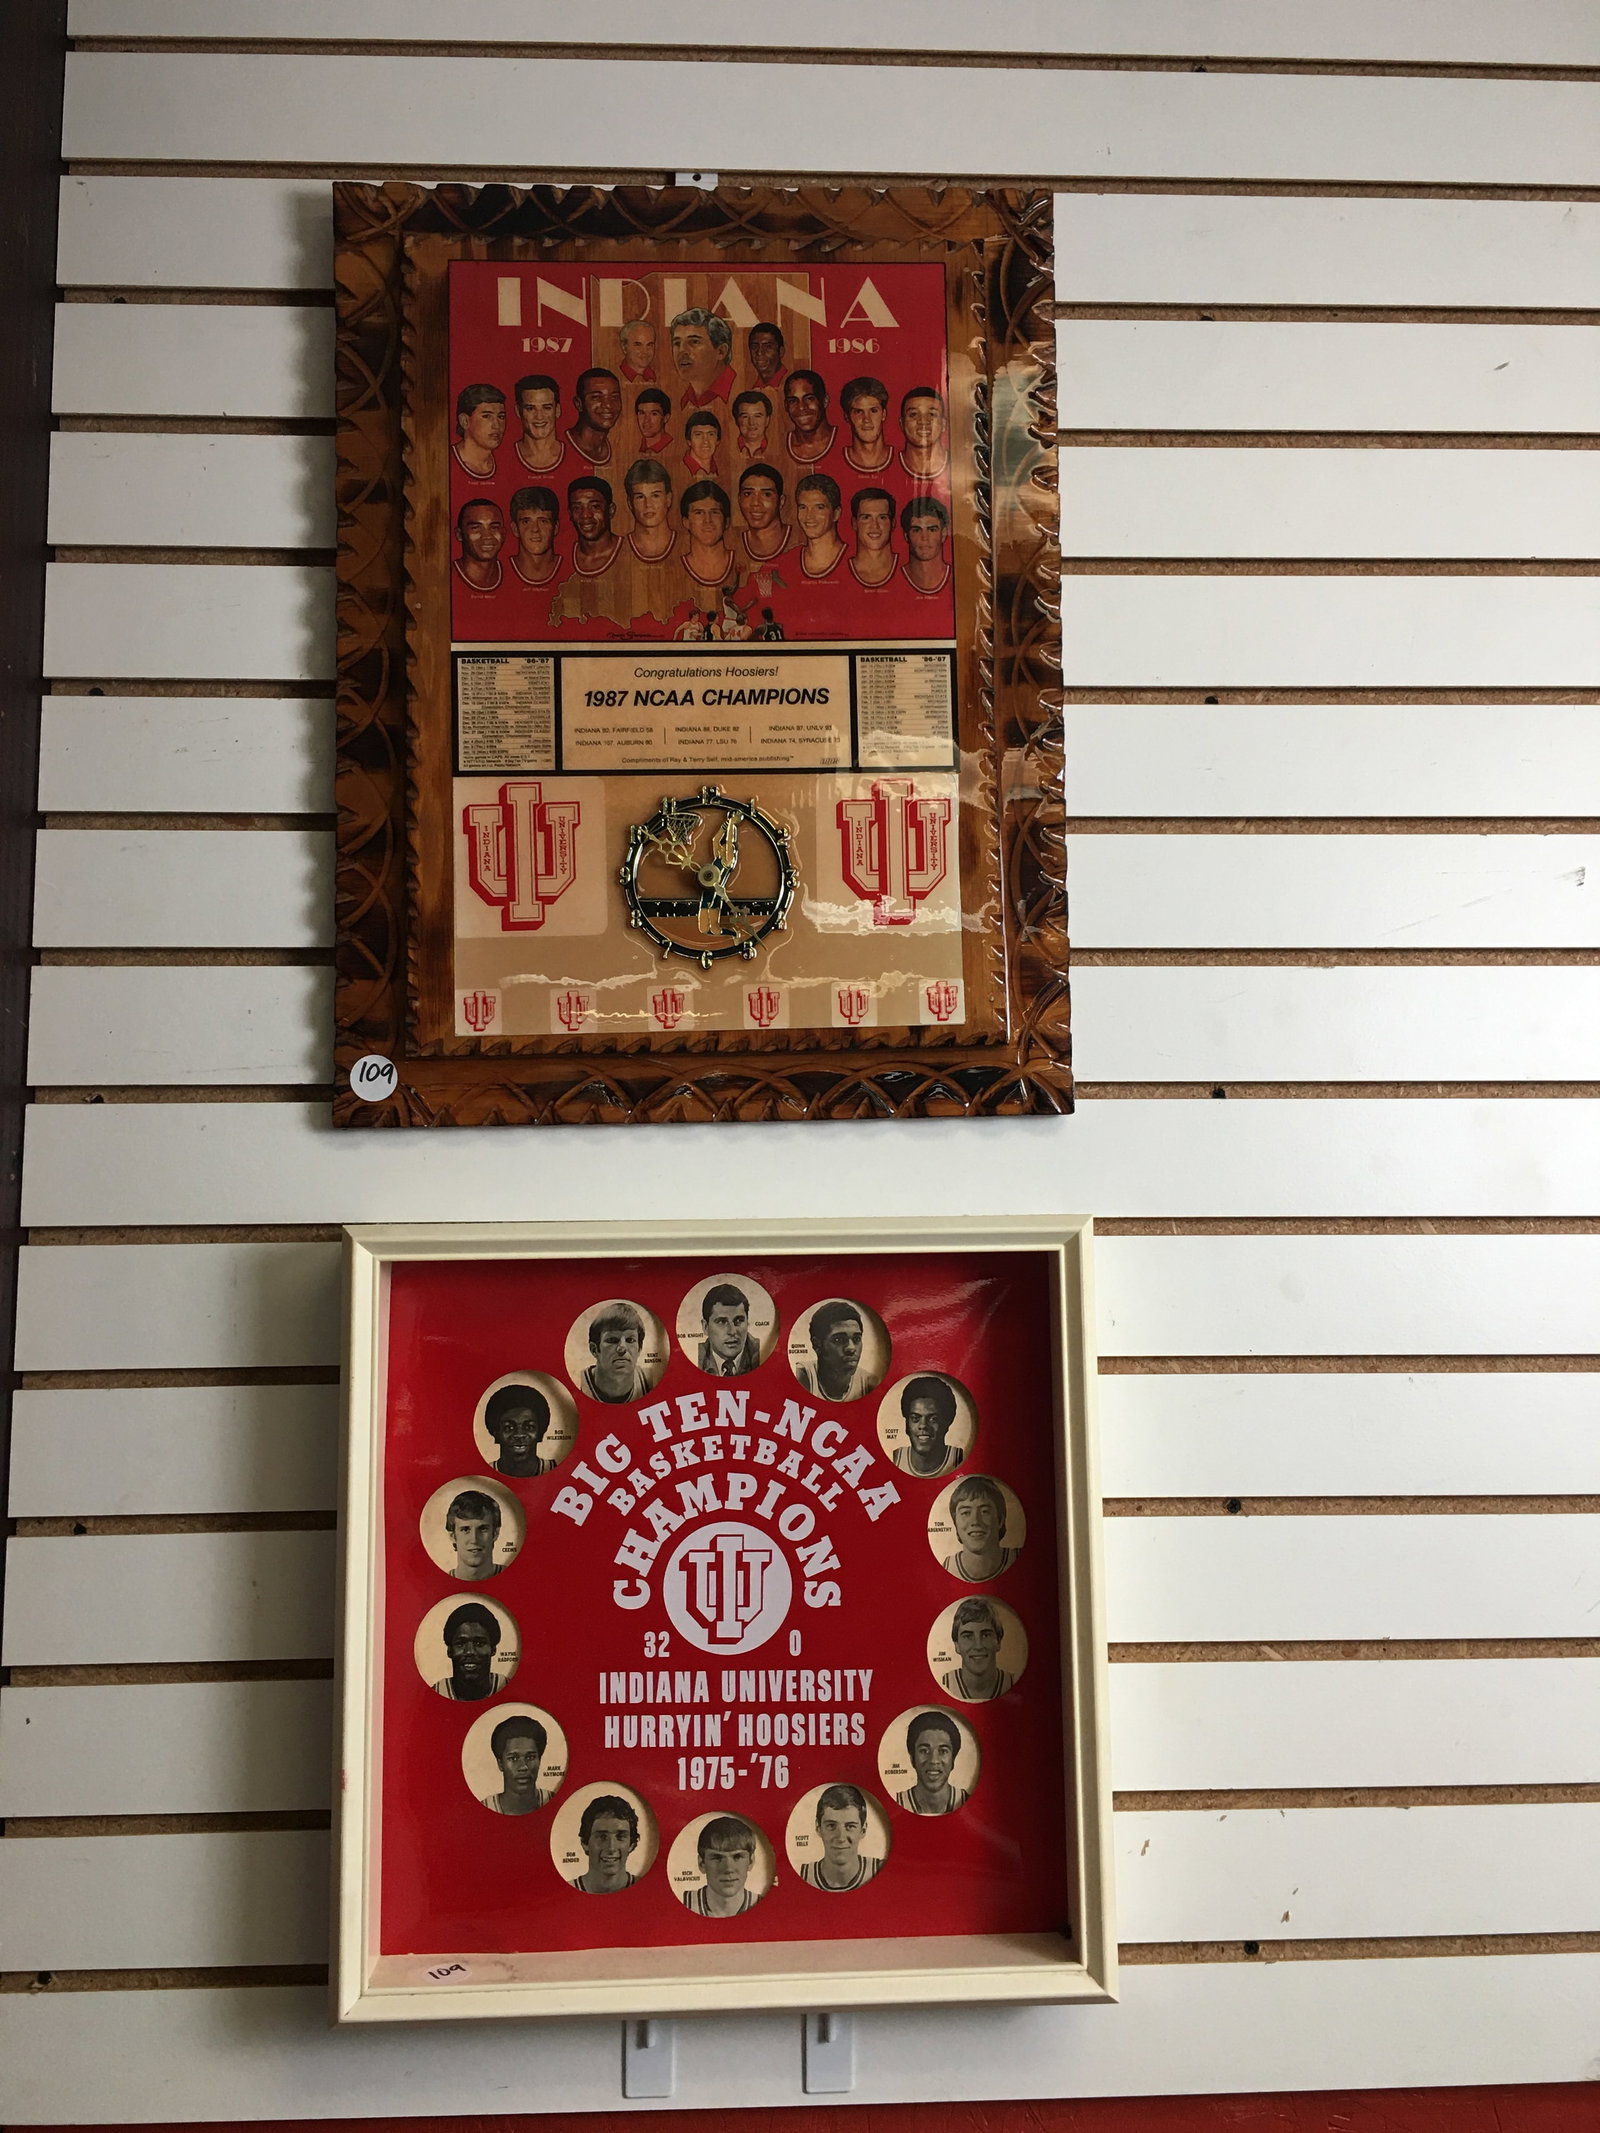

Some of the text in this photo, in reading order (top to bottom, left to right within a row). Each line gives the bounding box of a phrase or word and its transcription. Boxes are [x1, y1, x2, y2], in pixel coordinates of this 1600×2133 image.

[497, 276, 900, 328] INDIANA
[522, 336, 573, 353] 1987
[828, 337, 880, 354] 1986
[634, 666, 779, 678] Congratulations Hoosiers!
[584, 688, 830, 706] 1987 NCAA CHAMPIONS
[690, 756, 705, 764] Terry
[483, 825, 492, 872] INDIANA
[558, 816, 568, 874] UNIVERSITY
[856, 820, 864, 866] INDIANA
[928, 812, 938, 871] UNIVERSITY
[359, 1061, 394, 1084] 109
[754, 1320, 770, 1328] COACH
[550, 1389, 902, 1527] BIG TEN-NCAA
[606, 1434, 844, 1517] BASKETBALL
[613, 1472, 842, 1610] CHAMPIONS
[643, 1631, 670, 1658] 32
[599, 1668, 874, 1704] INDIANA UNIVERSITY
[604, 1710, 866, 1749] HURRYIN' HOOSIERS
[677, 1752, 790, 1792] 1975-'76
[428, 1964, 466, 1980] 109
